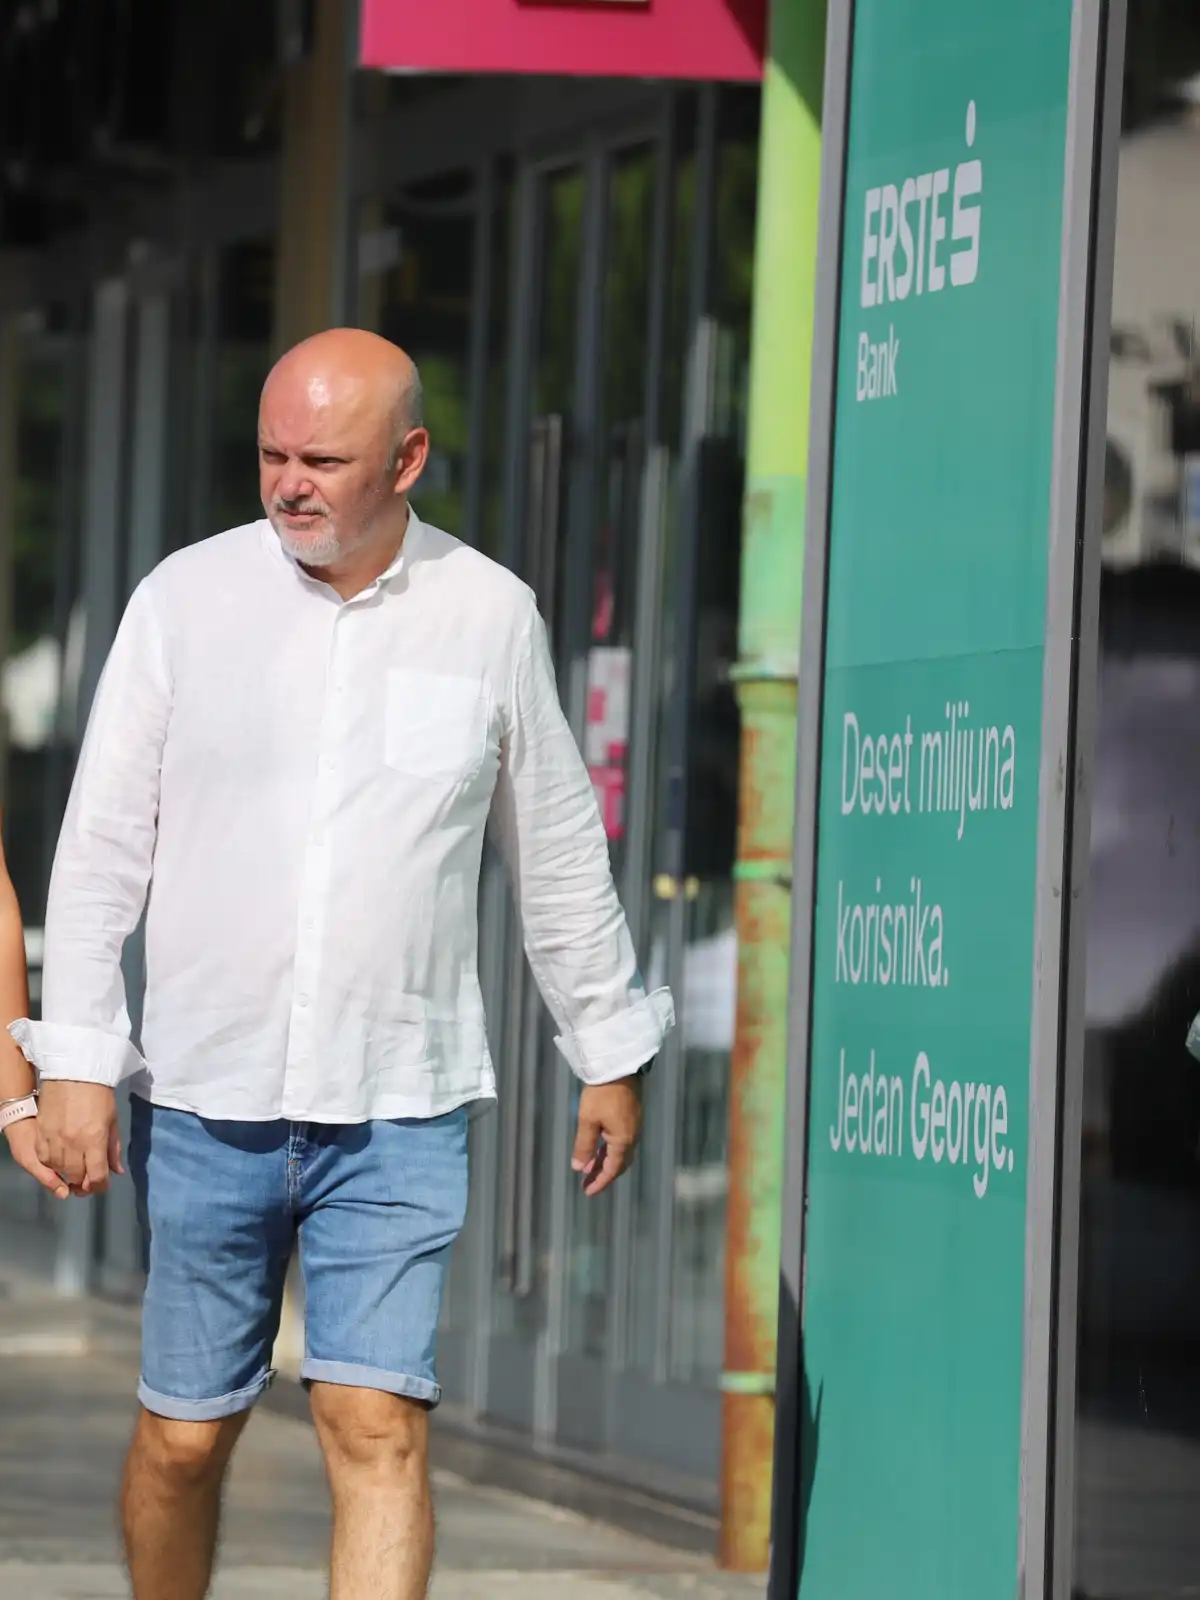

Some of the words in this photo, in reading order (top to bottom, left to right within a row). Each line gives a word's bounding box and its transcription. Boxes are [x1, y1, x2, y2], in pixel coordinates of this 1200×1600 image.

[856, 322, 899, 401] Bank
[840, 712, 913, 816] Deset
[918, 701, 1016, 841] milijuna
[834, 876, 948, 987] korisnika.
[829, 1047, 903, 1157] Jedan
[910, 1051, 1014, 1199] George.
